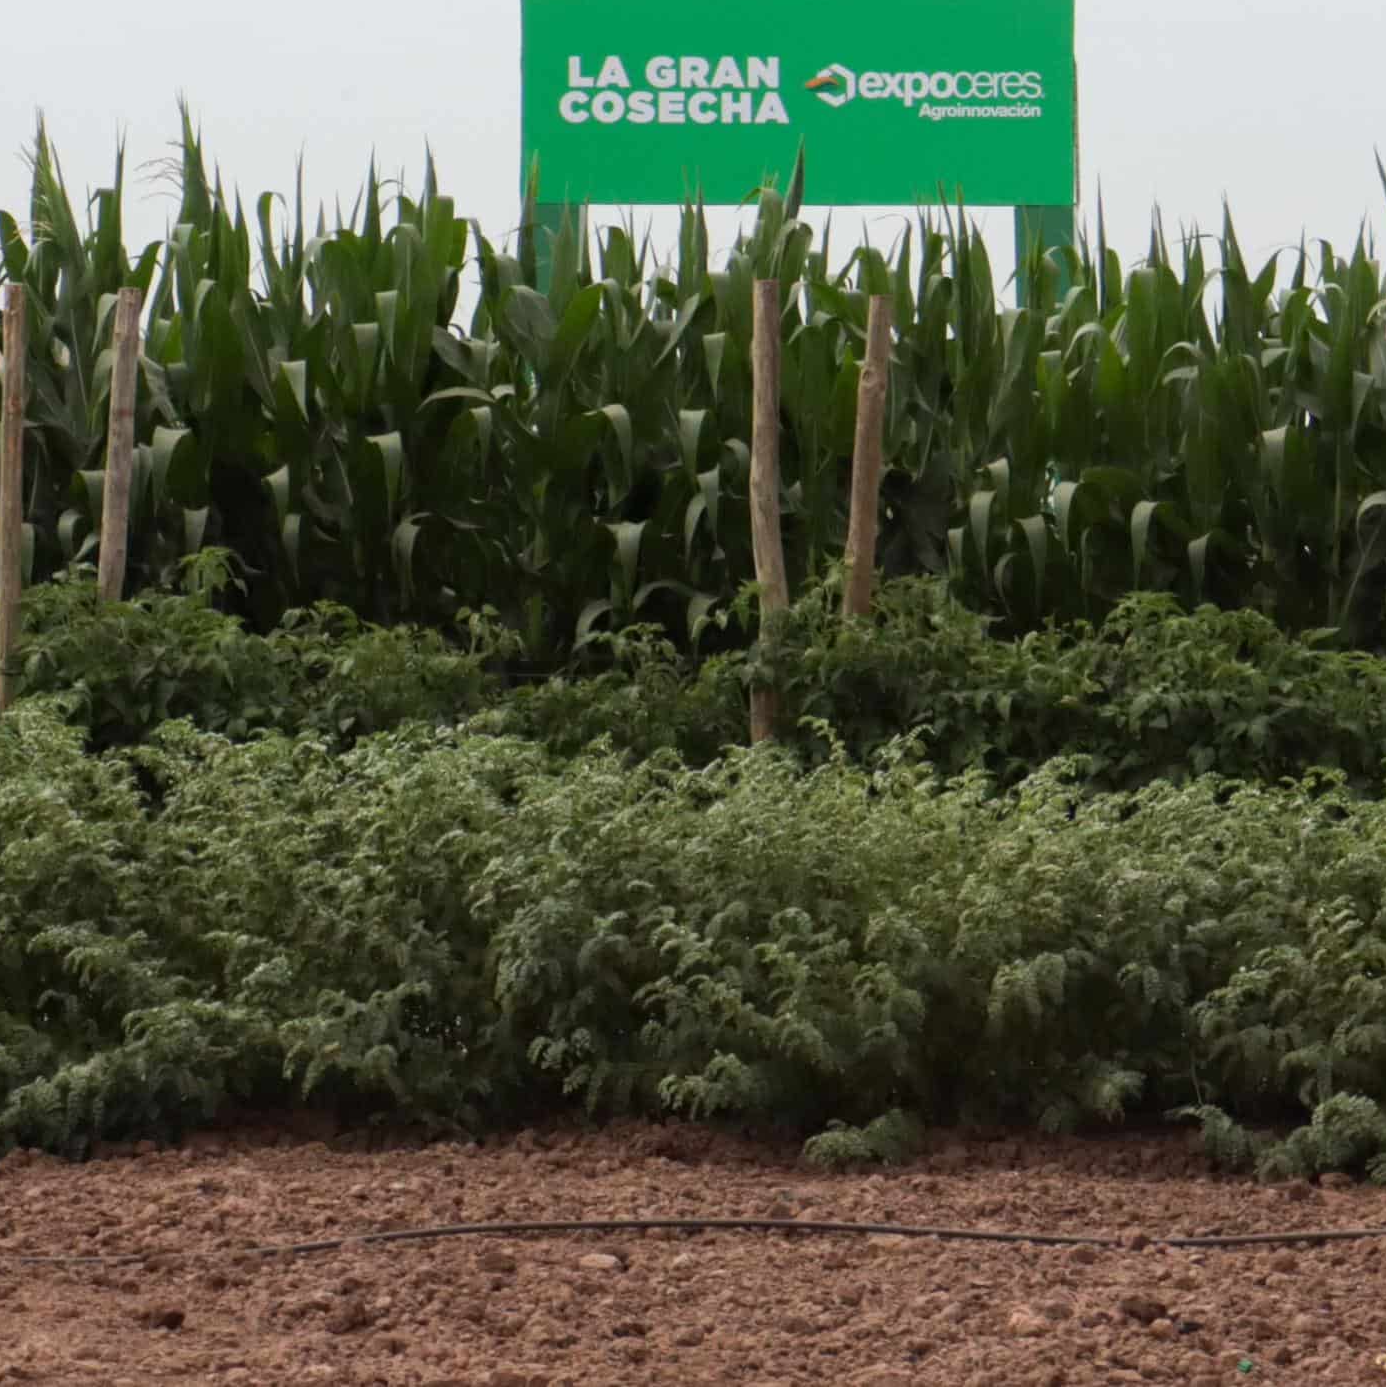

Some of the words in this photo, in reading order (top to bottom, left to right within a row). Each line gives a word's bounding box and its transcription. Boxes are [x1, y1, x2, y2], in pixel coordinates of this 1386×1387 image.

[568, 55, 631, 88] LA
[645, 55, 780, 89] GRAN
[858, 71, 1042, 107] expoceres
[558, 90, 790, 124] COSECHA
[918, 102, 1042, 121] Agroinnovación
